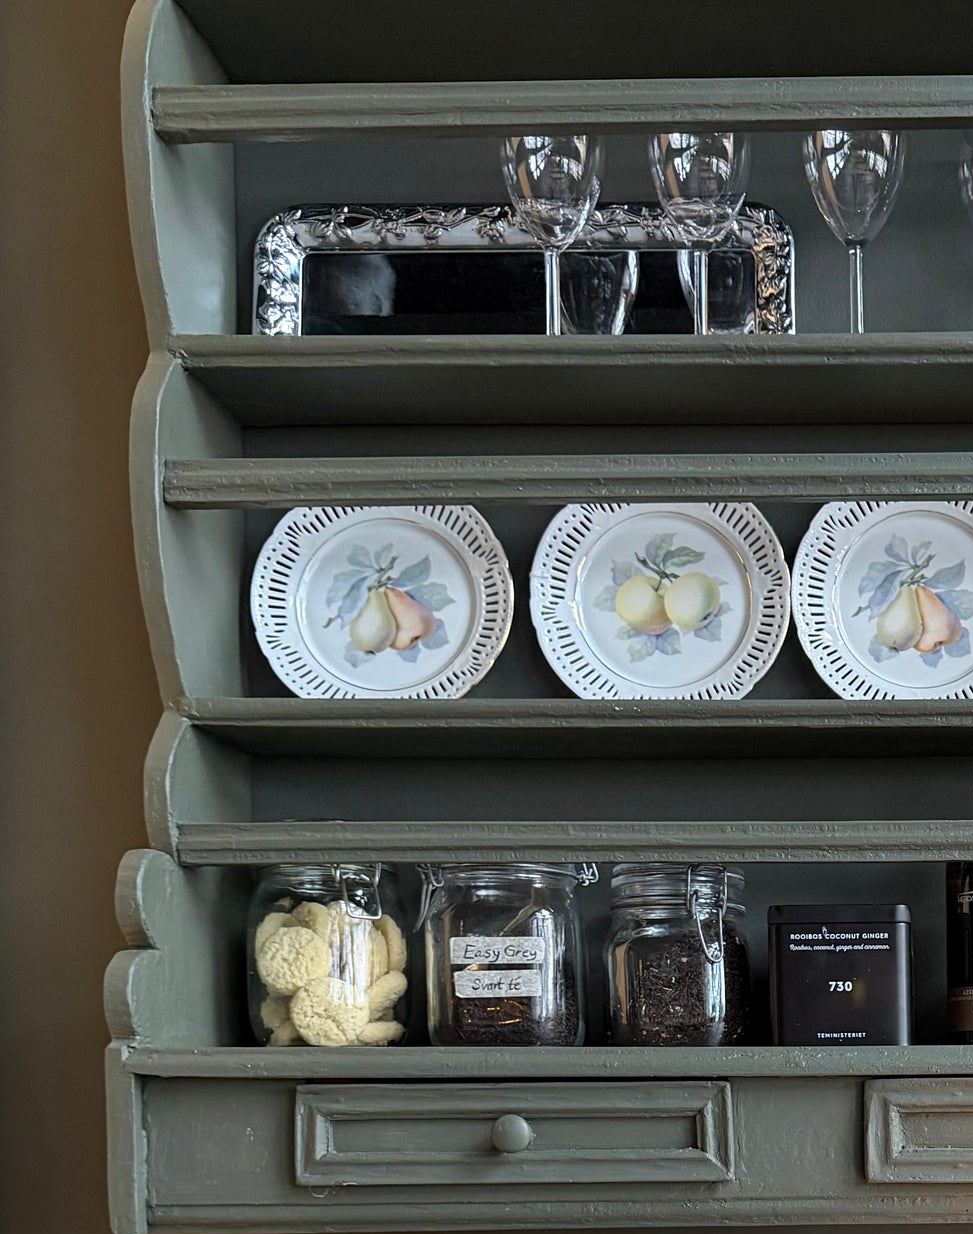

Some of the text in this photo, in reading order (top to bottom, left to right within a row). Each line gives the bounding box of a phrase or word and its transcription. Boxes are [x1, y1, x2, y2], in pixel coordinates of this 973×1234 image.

[463, 944, 538, 963] Easy Grey
[471, 976, 521, 991] Svart té
[828, 980, 853, 992] 730
